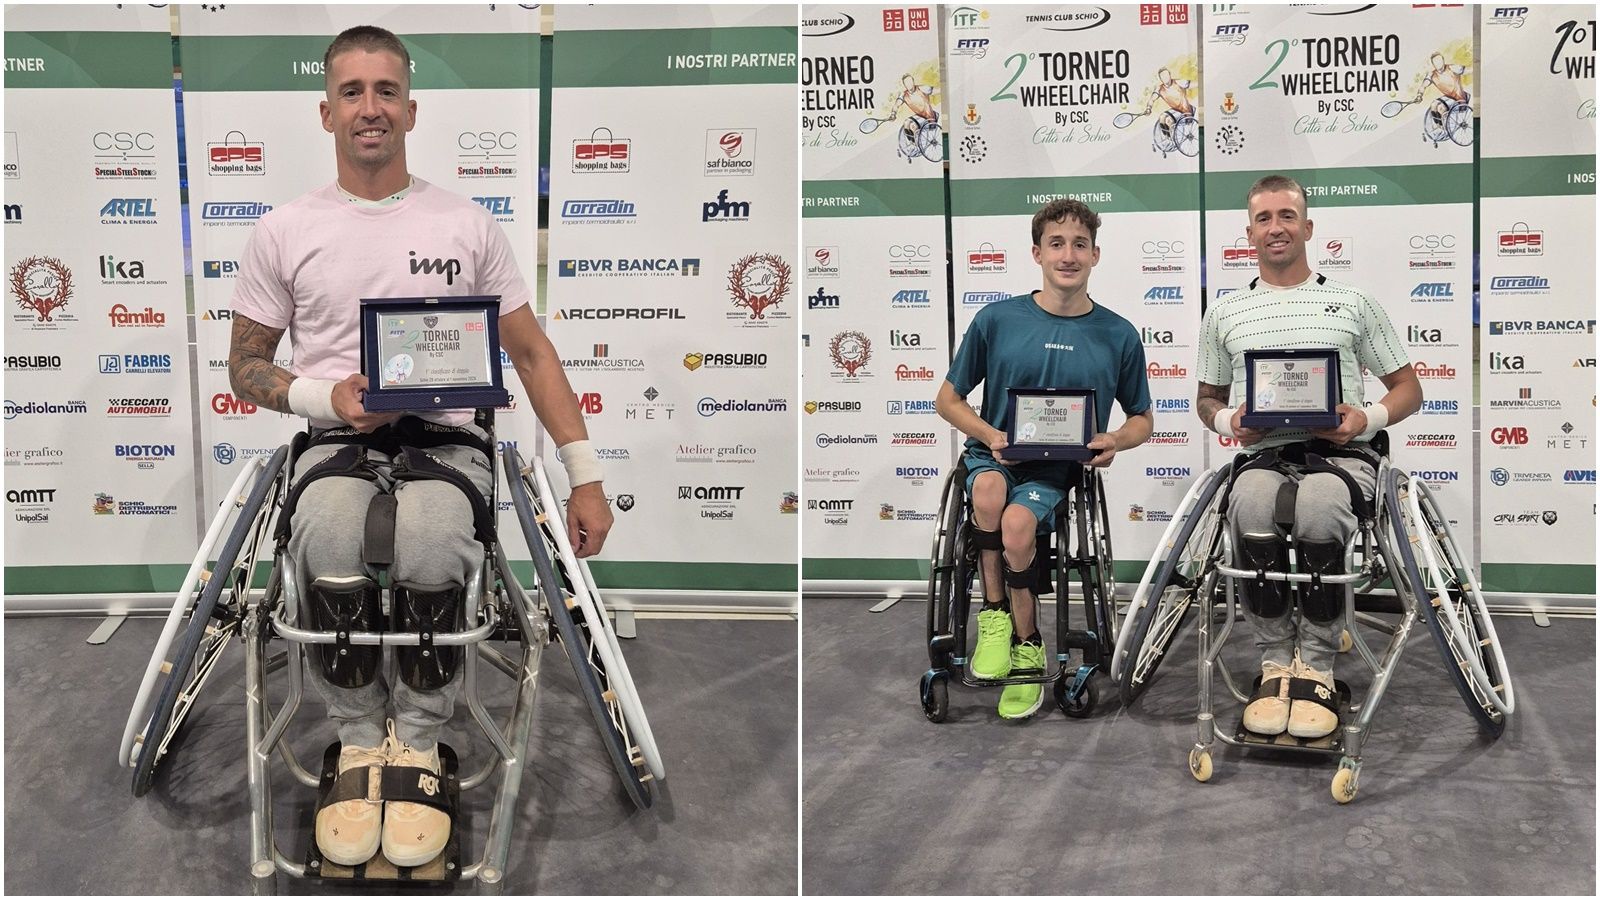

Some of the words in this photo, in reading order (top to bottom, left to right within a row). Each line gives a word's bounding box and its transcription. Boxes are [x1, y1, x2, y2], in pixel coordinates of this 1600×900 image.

[1054, 14, 1074, 22] CLUB
[1075, 13, 1099, 21] SCHIO
[1494, 7, 1528, 17] FITP
[954, 14, 978, 26] ITF
[1216, 24, 1249, 35] FITP
[958, 39, 989, 48] FITP
[1302, 34, 1400, 68] TORNEO
[667, 56, 671, 68] I
[676, 55, 726, 68] NOSTRI
[731, 53, 795, 67] PARTNER
[1039, 50, 1130, 81] TORNEO
[802, 55, 874, 86] ORNEO
[1282, 70, 1399, 95] WHEELCHAIR
[1021, 83, 1129, 107] WHEELCHAIR
[1318, 101, 1330, 115] By
[1334, 99, 1354, 112] CSC
[803, 116, 814, 131] By
[818, 116, 836, 128] CSC
[1055, 112, 1067, 127] By
[1070, 111, 1089, 123] CSC
[1342, 113, 1378, 134] Schio
[1078, 124, 1110, 144] Schio
[93, 132, 154, 150] CSC
[458, 132, 517, 150] CSC
[211, 164, 243, 172] shopping
[246, 164, 262, 172] bags
[575, 162, 608, 170] shopping
[610, 161, 626, 169] bags
[707, 159, 720, 167] saf
[722, 158, 752, 167] bianco
[1331, 185, 1377, 195] PARTNER
[818, 197, 860, 206] PARTNER
[1069, 193, 1112, 202] PARTNER
[100, 199, 156, 217] ARTEL
[1142, 241, 1184, 254] CSC
[1409, 235, 1456, 248] CSC
[889, 245, 930, 257] CSC
[100, 255, 144, 278] lika
[578, 260, 612, 271] BVR
[618, 259, 679, 271] BANCA
[1144, 287, 1183, 300] ARTEL
[1410, 283, 1454, 297] ARTEL
[892, 290, 930, 303] ARTEL
[108, 304, 165, 327] famila
[1505, 321, 1532, 330] BVR
[1537, 321, 1585, 330] BANCA
[423, 330, 459, 341] TORNEO
[890, 330, 920, 346] lika
[1142, 328, 1173, 344] lika
[1408, 325, 1441, 342] lika
[416, 342, 460, 351] WHEELCHAIR
[125, 355, 171, 367] FABRIS
[704, 354, 767, 365] PASUBIO
[1490, 352, 1524, 369] lika
[895, 364, 934, 380] famila
[1283, 372, 1308, 380] TORNEO
[4, 400, 87, 414] mediolanum
[701, 400, 786, 411] mediolanum
[818, 402, 861, 410] PASUBIO
[905, 401, 936, 410] FABRIS
[1157, 399, 1190, 408] FABRIS
[1422, 401, 1458, 410] FABRIS
[818, 436, 878, 444] mediolanum
[1491, 427, 1528, 444] GMB
[25, 448, 63, 459] grafico
[115, 445, 174, 457] BIOTON
[676, 445, 715, 454] Atelier
[718, 445, 756, 457] grafico
[833, 468, 860, 477] grafico
[896, 468, 938, 476] BIOTON
[1146, 467, 1190, 476] BIOTON
